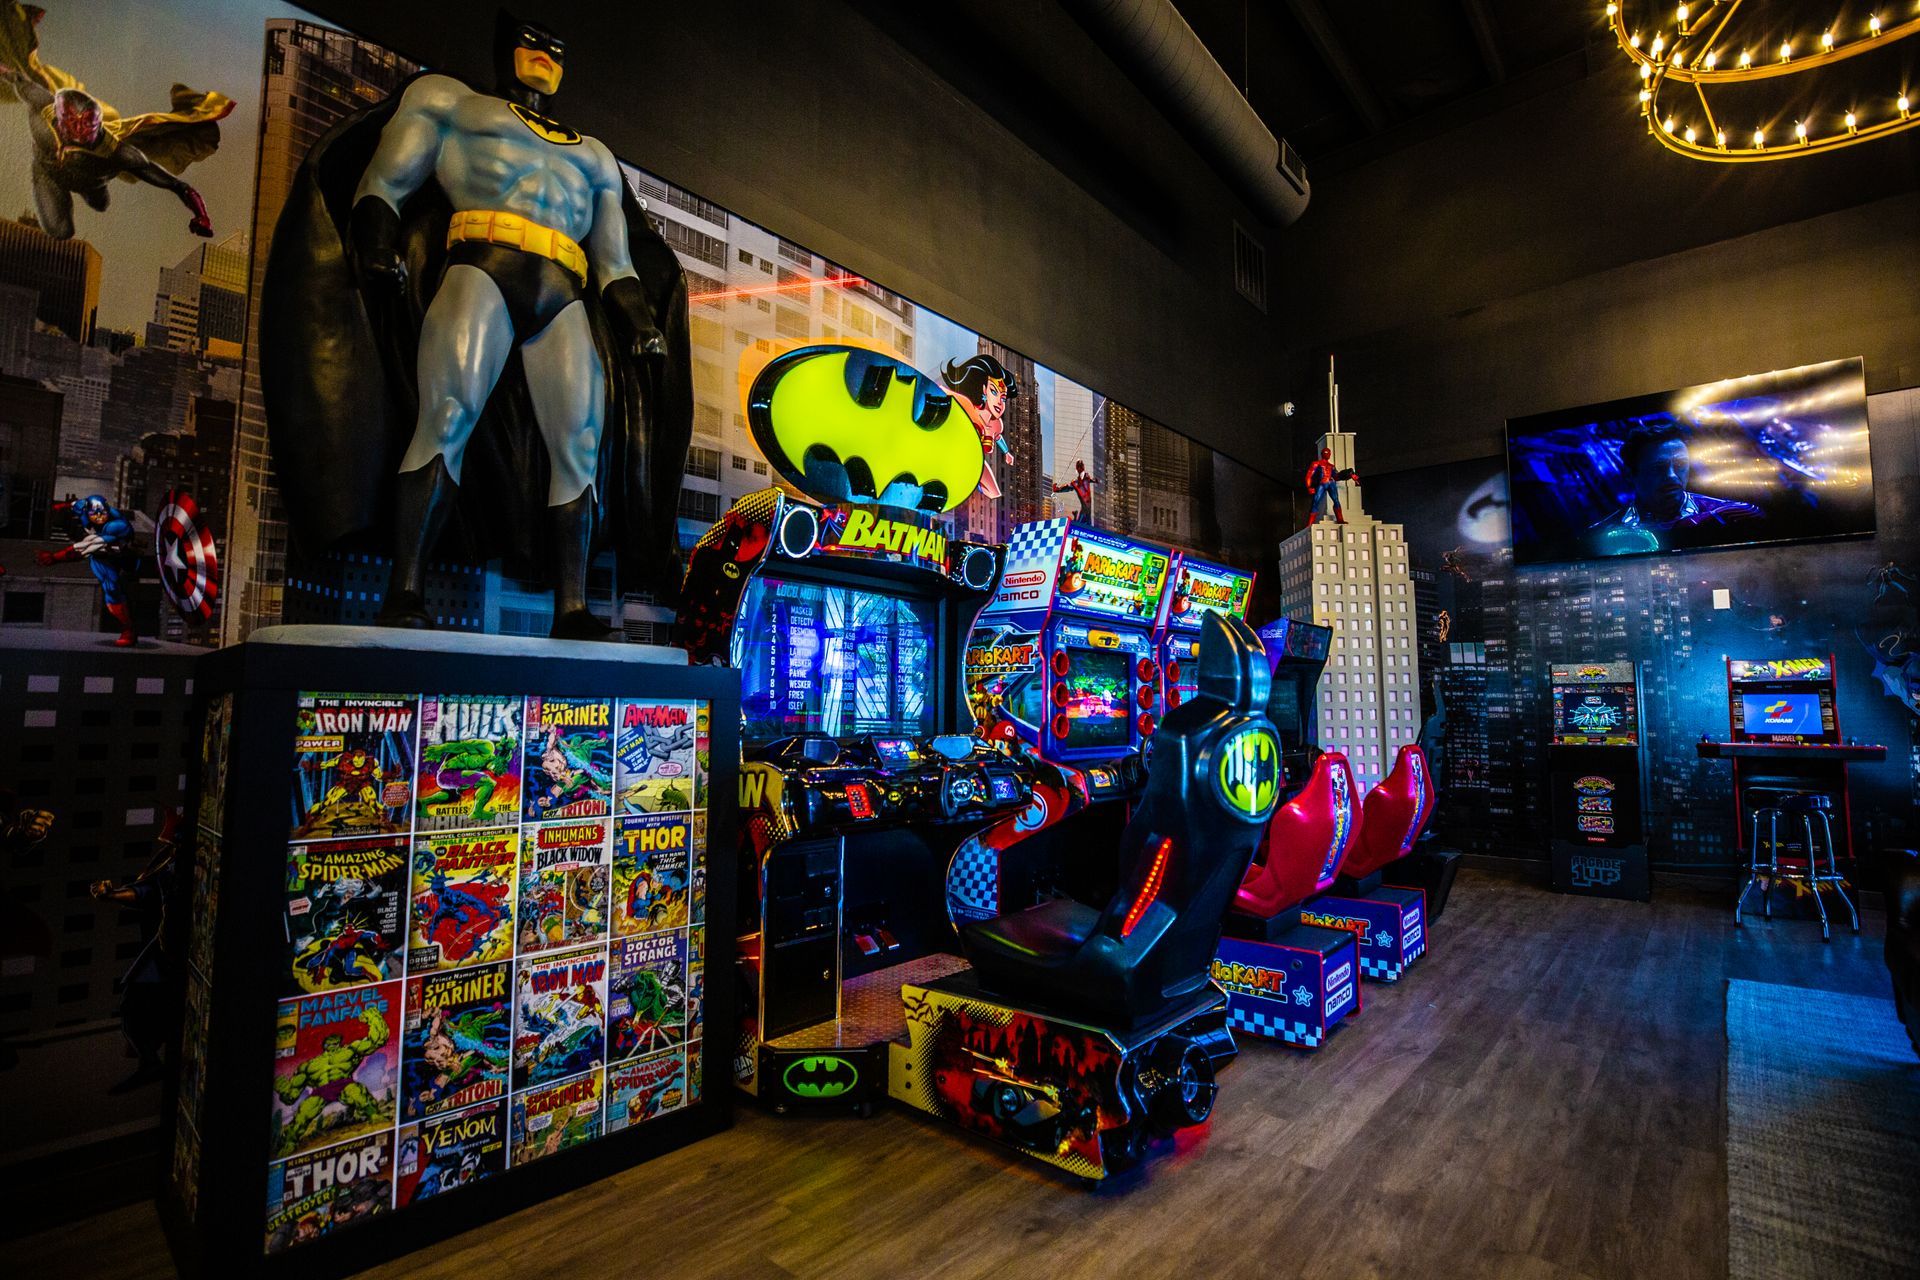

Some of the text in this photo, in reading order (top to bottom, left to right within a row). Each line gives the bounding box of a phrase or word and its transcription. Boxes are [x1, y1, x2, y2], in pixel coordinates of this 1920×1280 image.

[839, 510, 946, 564] BATMAN
[1005, 575, 1042, 585] Nintendo
[776, 584, 798, 598] LOCO
[771, 614, 777, 622] 2
[771, 625, 777, 633] 3
[771, 635, 776, 644] 4
[771, 646, 776, 655] 5
[770, 657, 776, 666] 6
[1768, 658, 1825, 679] X-MEN
[770, 668, 776, 676] 7
[770, 678, 775, 688] 8
[788, 680, 811, 689] WESKER
[769, 690, 804, 700] 9 FRIES
[541, 704, 609, 726] MARINER
[787, 701, 804, 710] ISLEY
[315, 708, 364, 732] IRON
[368, 708, 412, 732] MAN
[428, 695, 520, 745] HULK
[436, 807, 468, 815] BATTLES
[544, 800, 605, 818] CRY TRITON!
[544, 827, 598, 843] INHUMANS
[623, 826, 686, 854] THOR
[324, 848, 386, 864] AMAZING
[446, 841, 509, 858] BLACK
[537, 849, 568, 870] BLACK
[570, 848, 603, 864] WIDOW
[434, 852, 516, 872] PANTHER
[627, 936, 674, 952] DOCTOR
[536, 954, 598, 971] THE INVINCIBLE
[624, 944, 677, 966] STRANGE
[531, 967, 568, 995] IRON
[571, 959, 606, 987] MAN
[1327, 966, 1350, 989] Nintendo
[301, 987, 382, 1014] MARVEL
[424, 972, 505, 1011] MARINER
[1327, 990, 1351, 1014] namco
[447, 1079, 502, 1108] TRITON!
[526, 1078, 594, 1118] MARINER
[421, 1115, 496, 1155] VENOM
[286, 1145, 382, 1199] THOR
